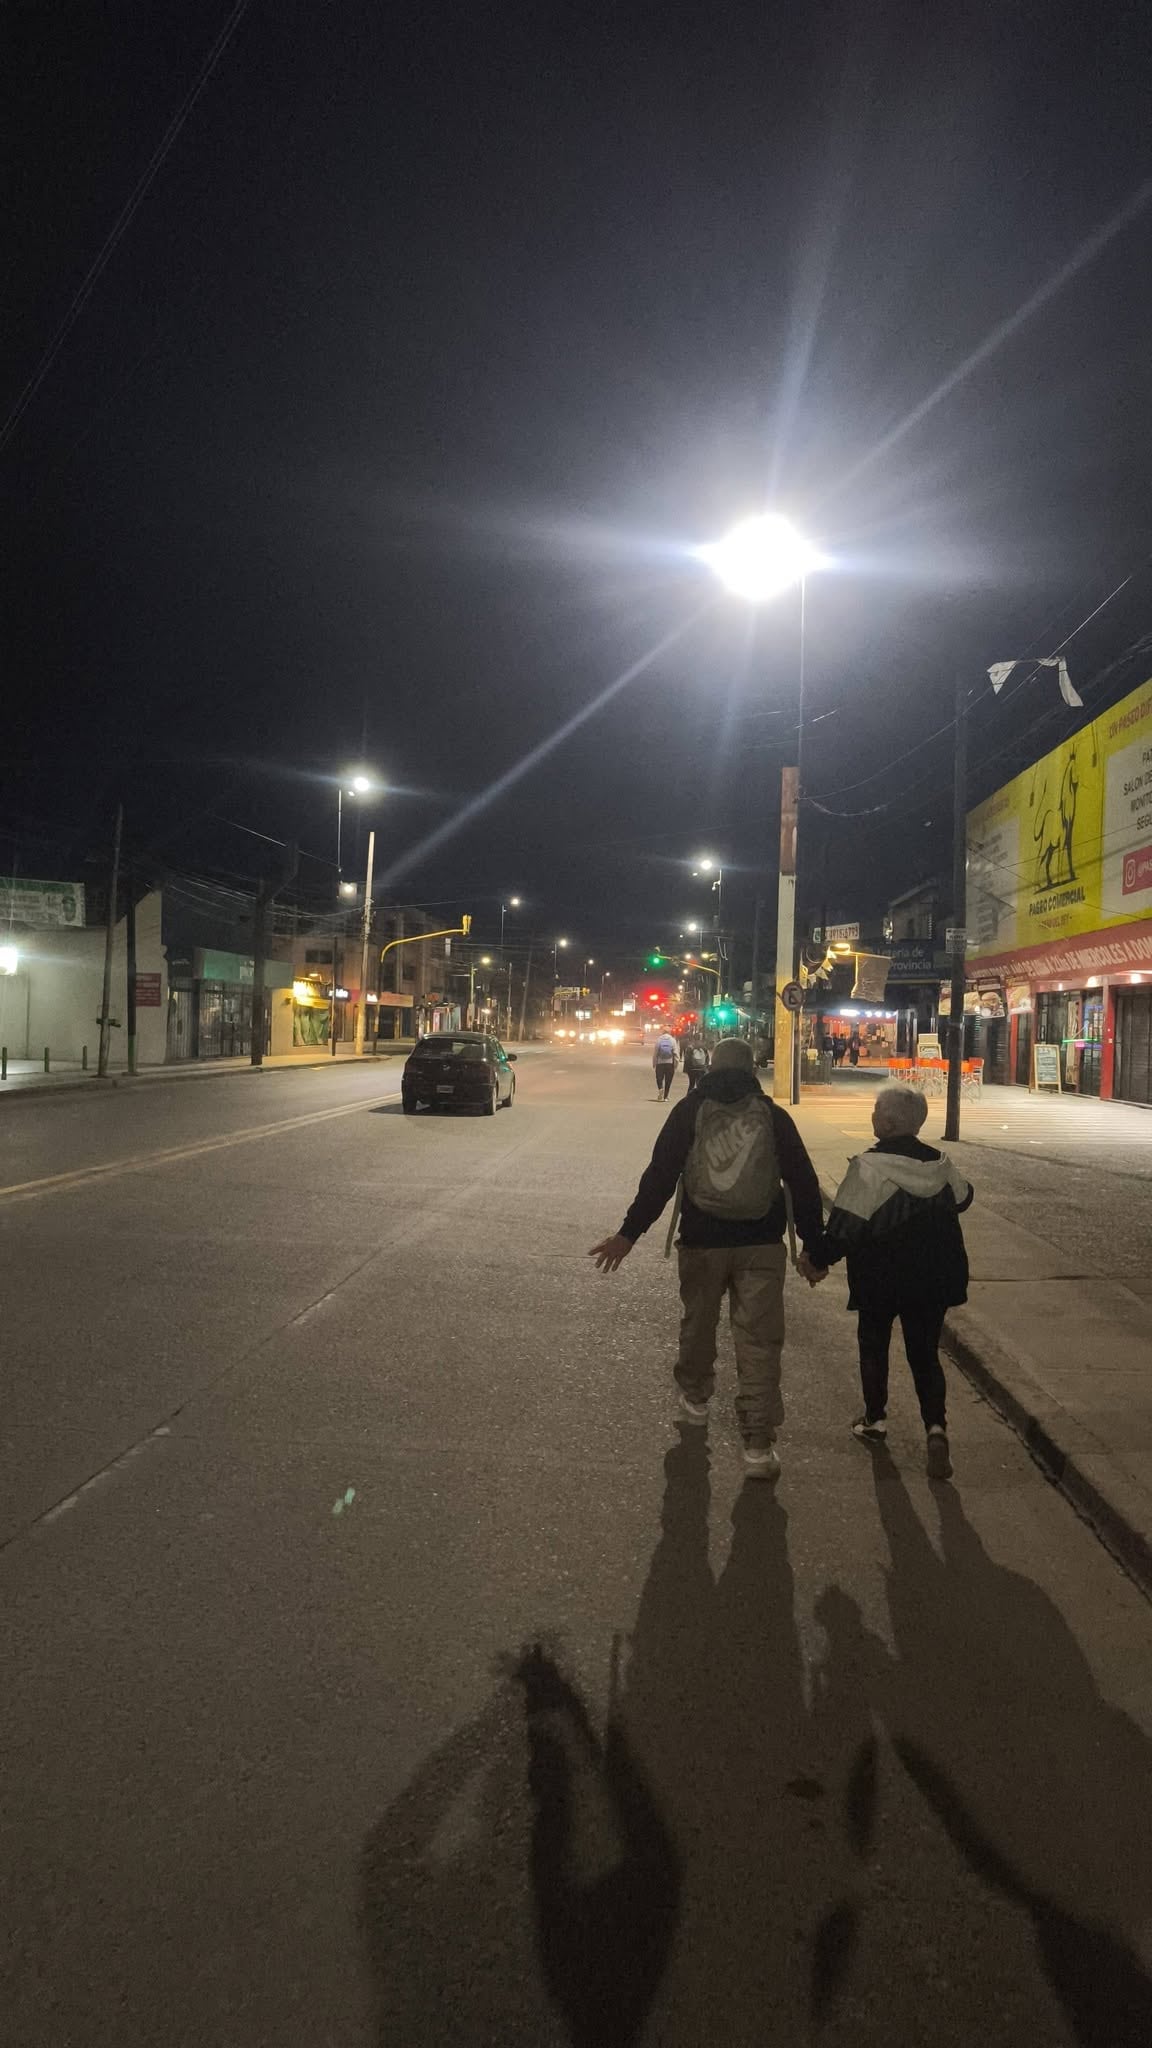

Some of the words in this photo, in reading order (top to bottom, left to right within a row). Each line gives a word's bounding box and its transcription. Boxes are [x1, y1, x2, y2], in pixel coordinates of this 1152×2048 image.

[1123, 775, 1143, 796] SALON
[1048, 887, 1085, 911] COMERCIAL
[911, 945, 925, 957] de
[1075, 943, 1128, 969] MIERCOLES
[889, 958, 932, 970] Provincia
